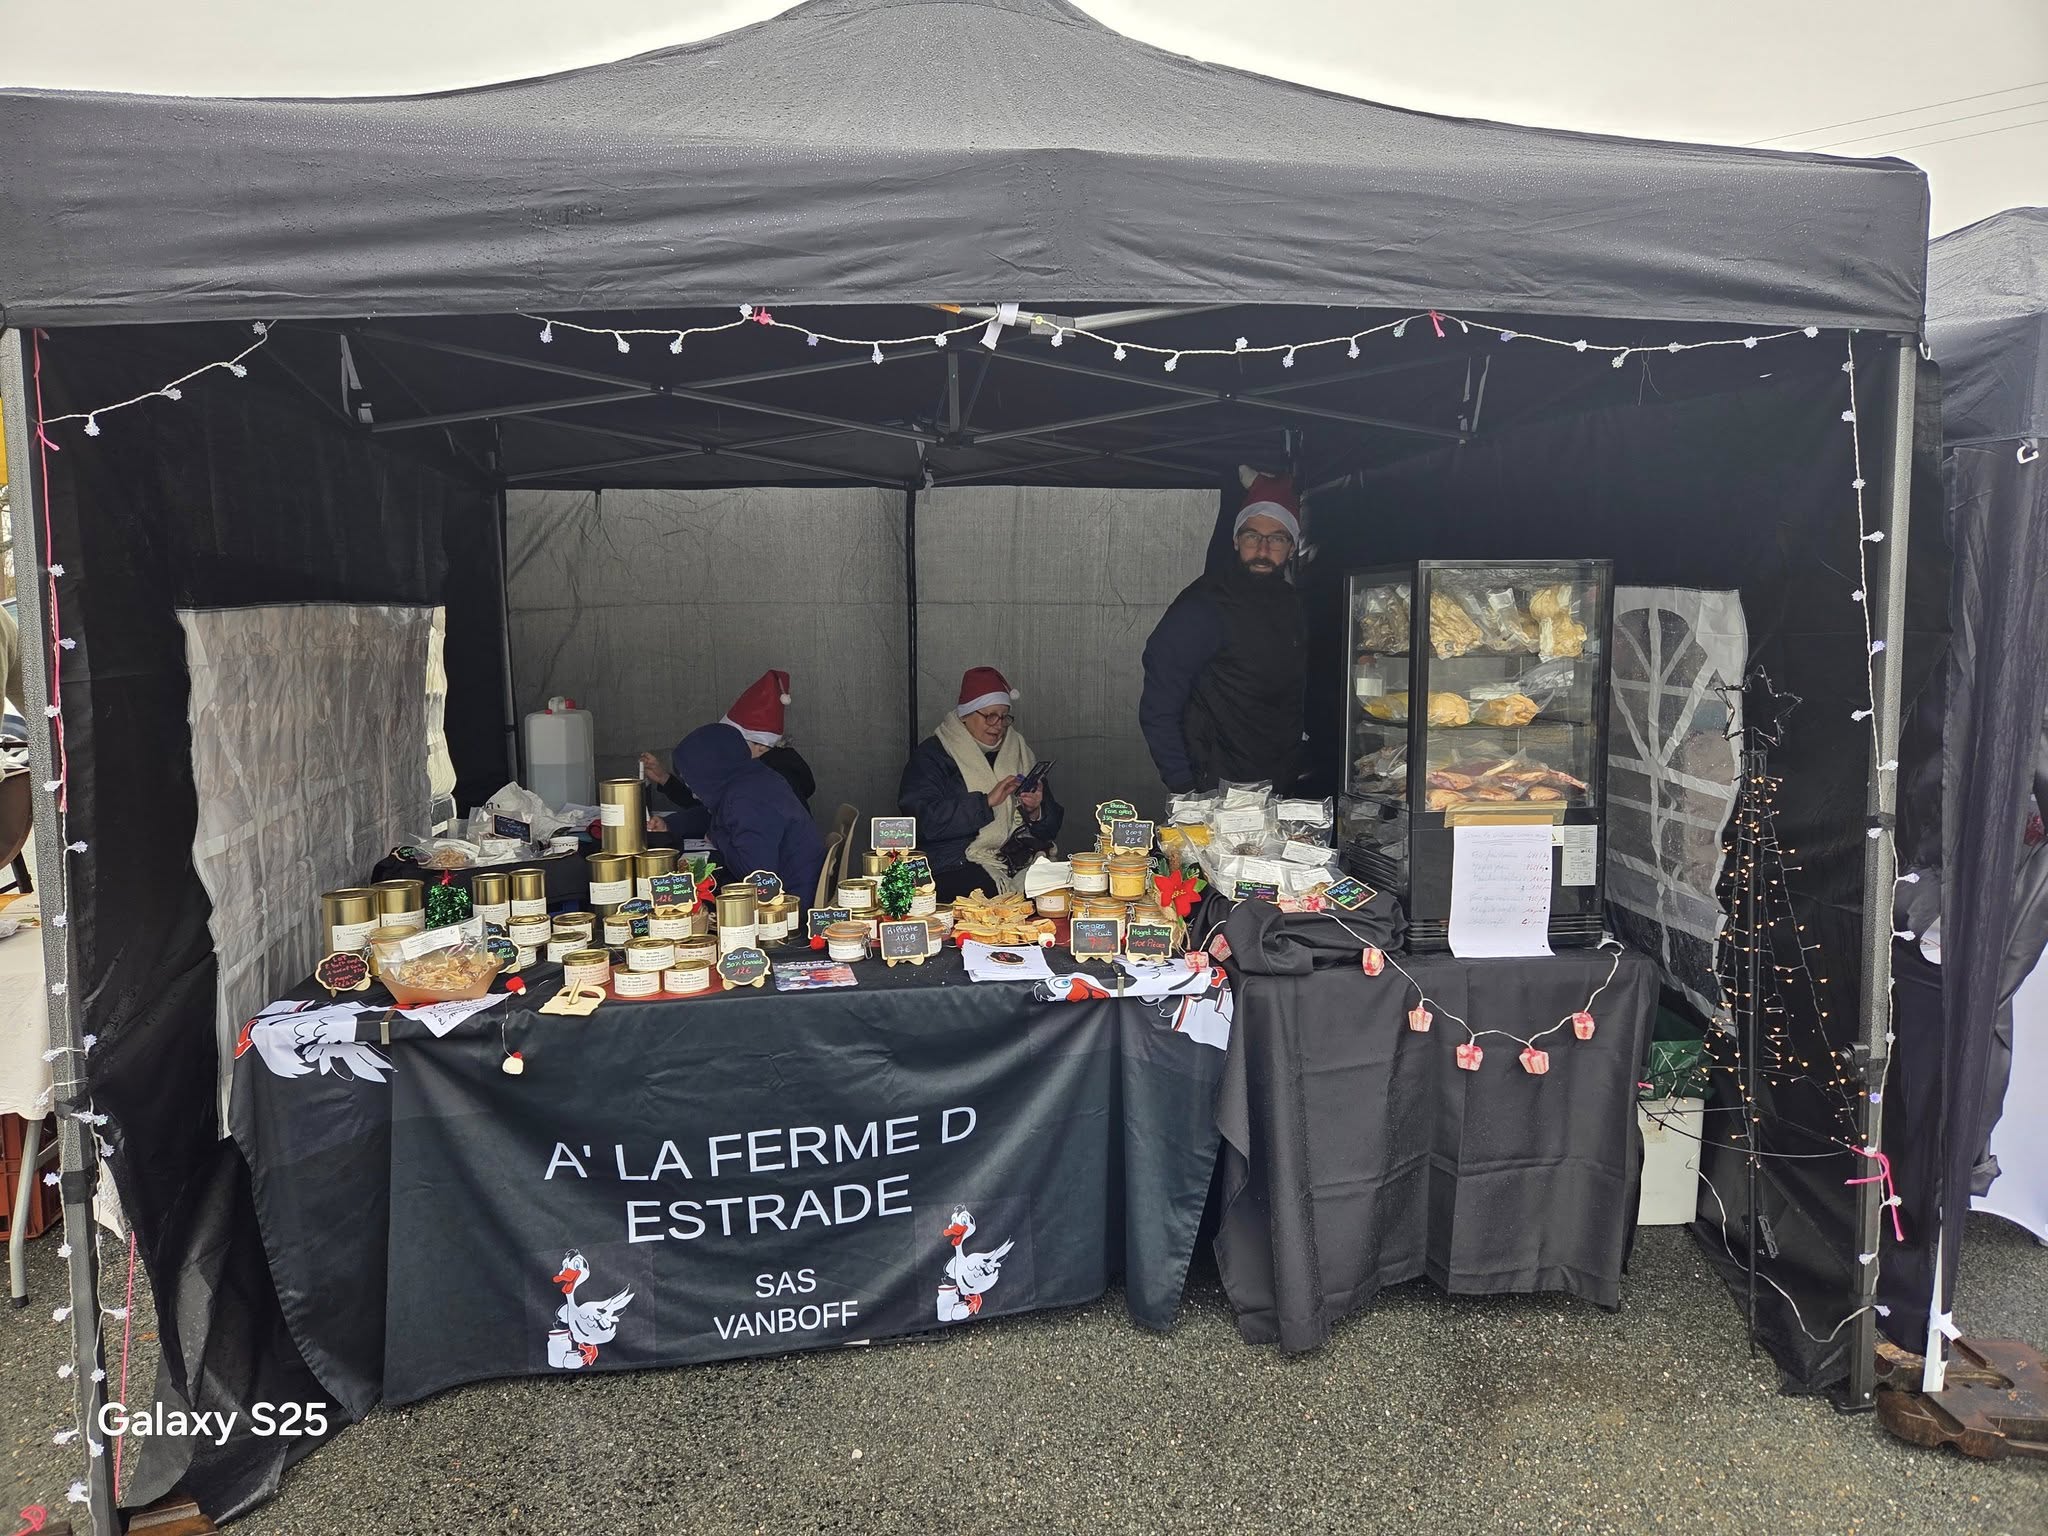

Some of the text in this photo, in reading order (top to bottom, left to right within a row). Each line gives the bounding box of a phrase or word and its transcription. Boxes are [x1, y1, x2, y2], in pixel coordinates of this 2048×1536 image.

[614, 1139, 693, 1181] LA
[708, 1115, 920, 1177] FERME
[941, 1106, 977, 1144] D
[626, 1173, 913, 1244] ESTRADE
[755, 1268, 817, 1298] SAS
[713, 1299, 859, 1340] VANBOFF
